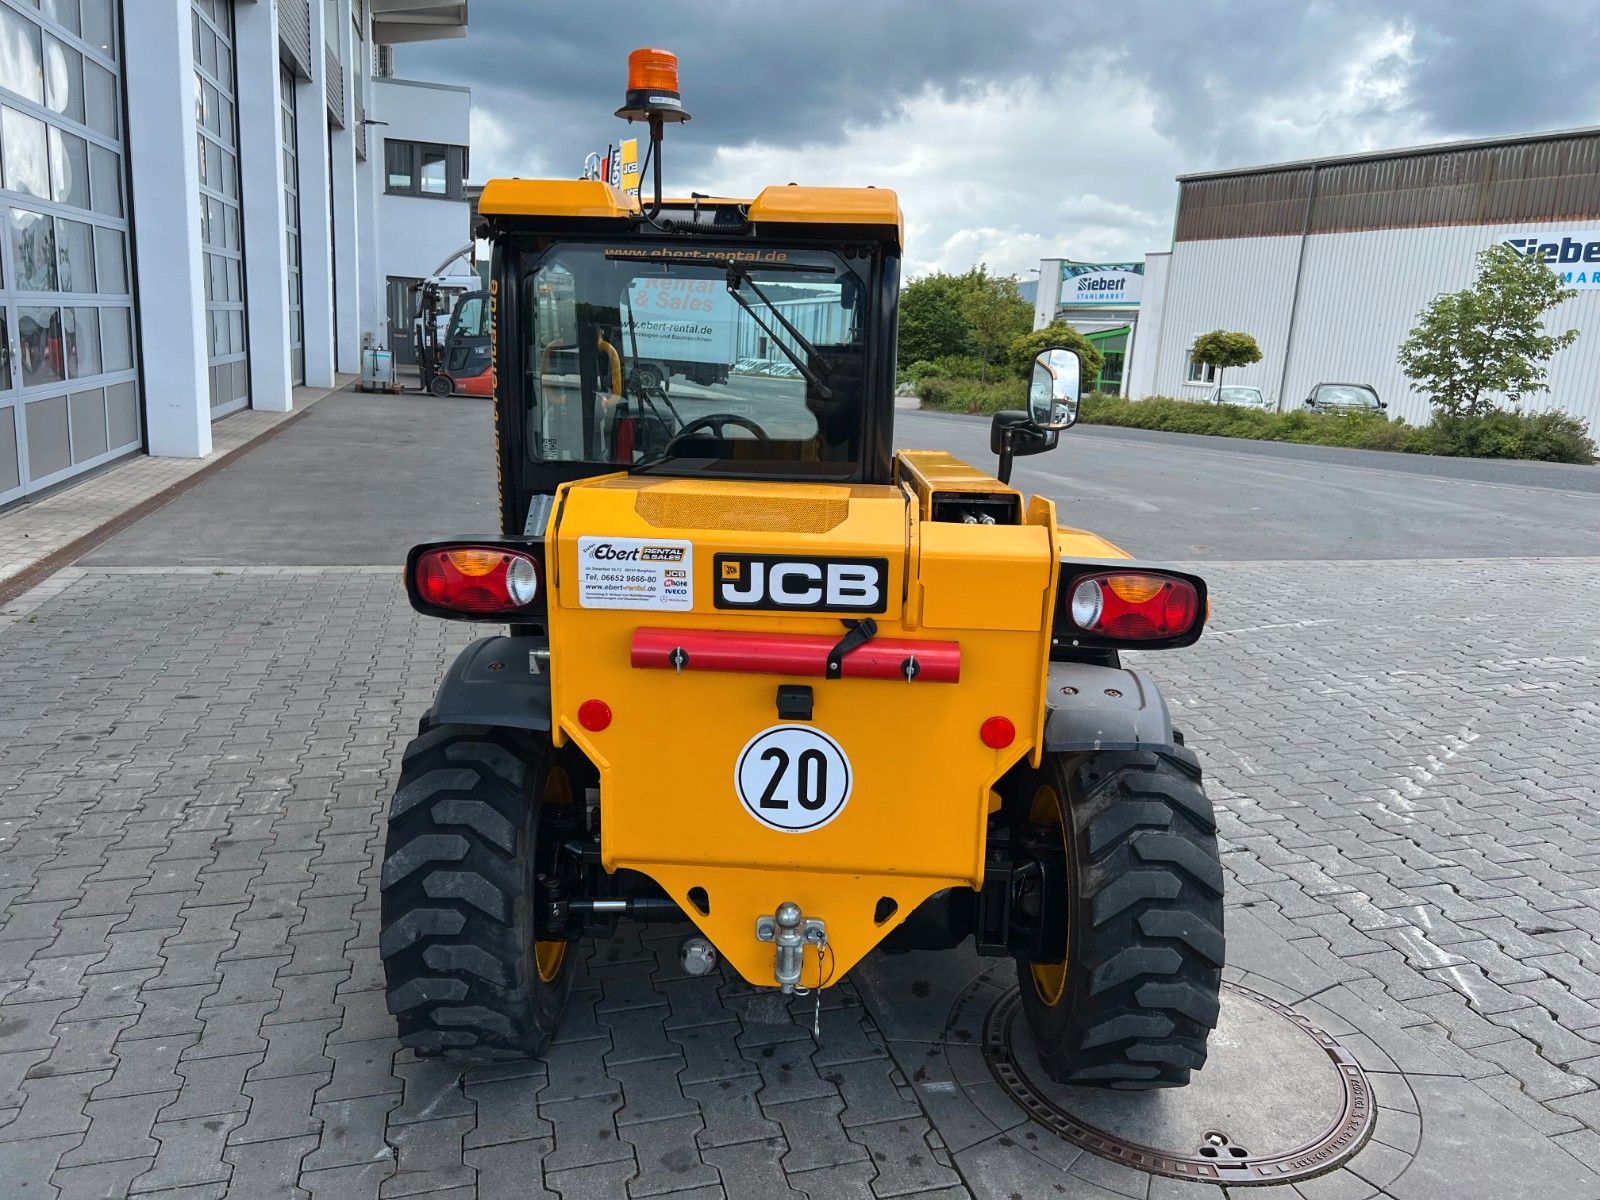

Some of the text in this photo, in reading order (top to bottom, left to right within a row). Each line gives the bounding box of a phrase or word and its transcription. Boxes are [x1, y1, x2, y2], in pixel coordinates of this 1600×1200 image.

[605, 248, 787, 262] wwwebert-rental.de
[656, 291, 714, 313] Sales
[594, 543, 682, 561] Ebert RENTAL
[601, 574, 625, 582] 06652
[721, 561, 880, 606] JCB
[759, 746, 828, 811] 20
